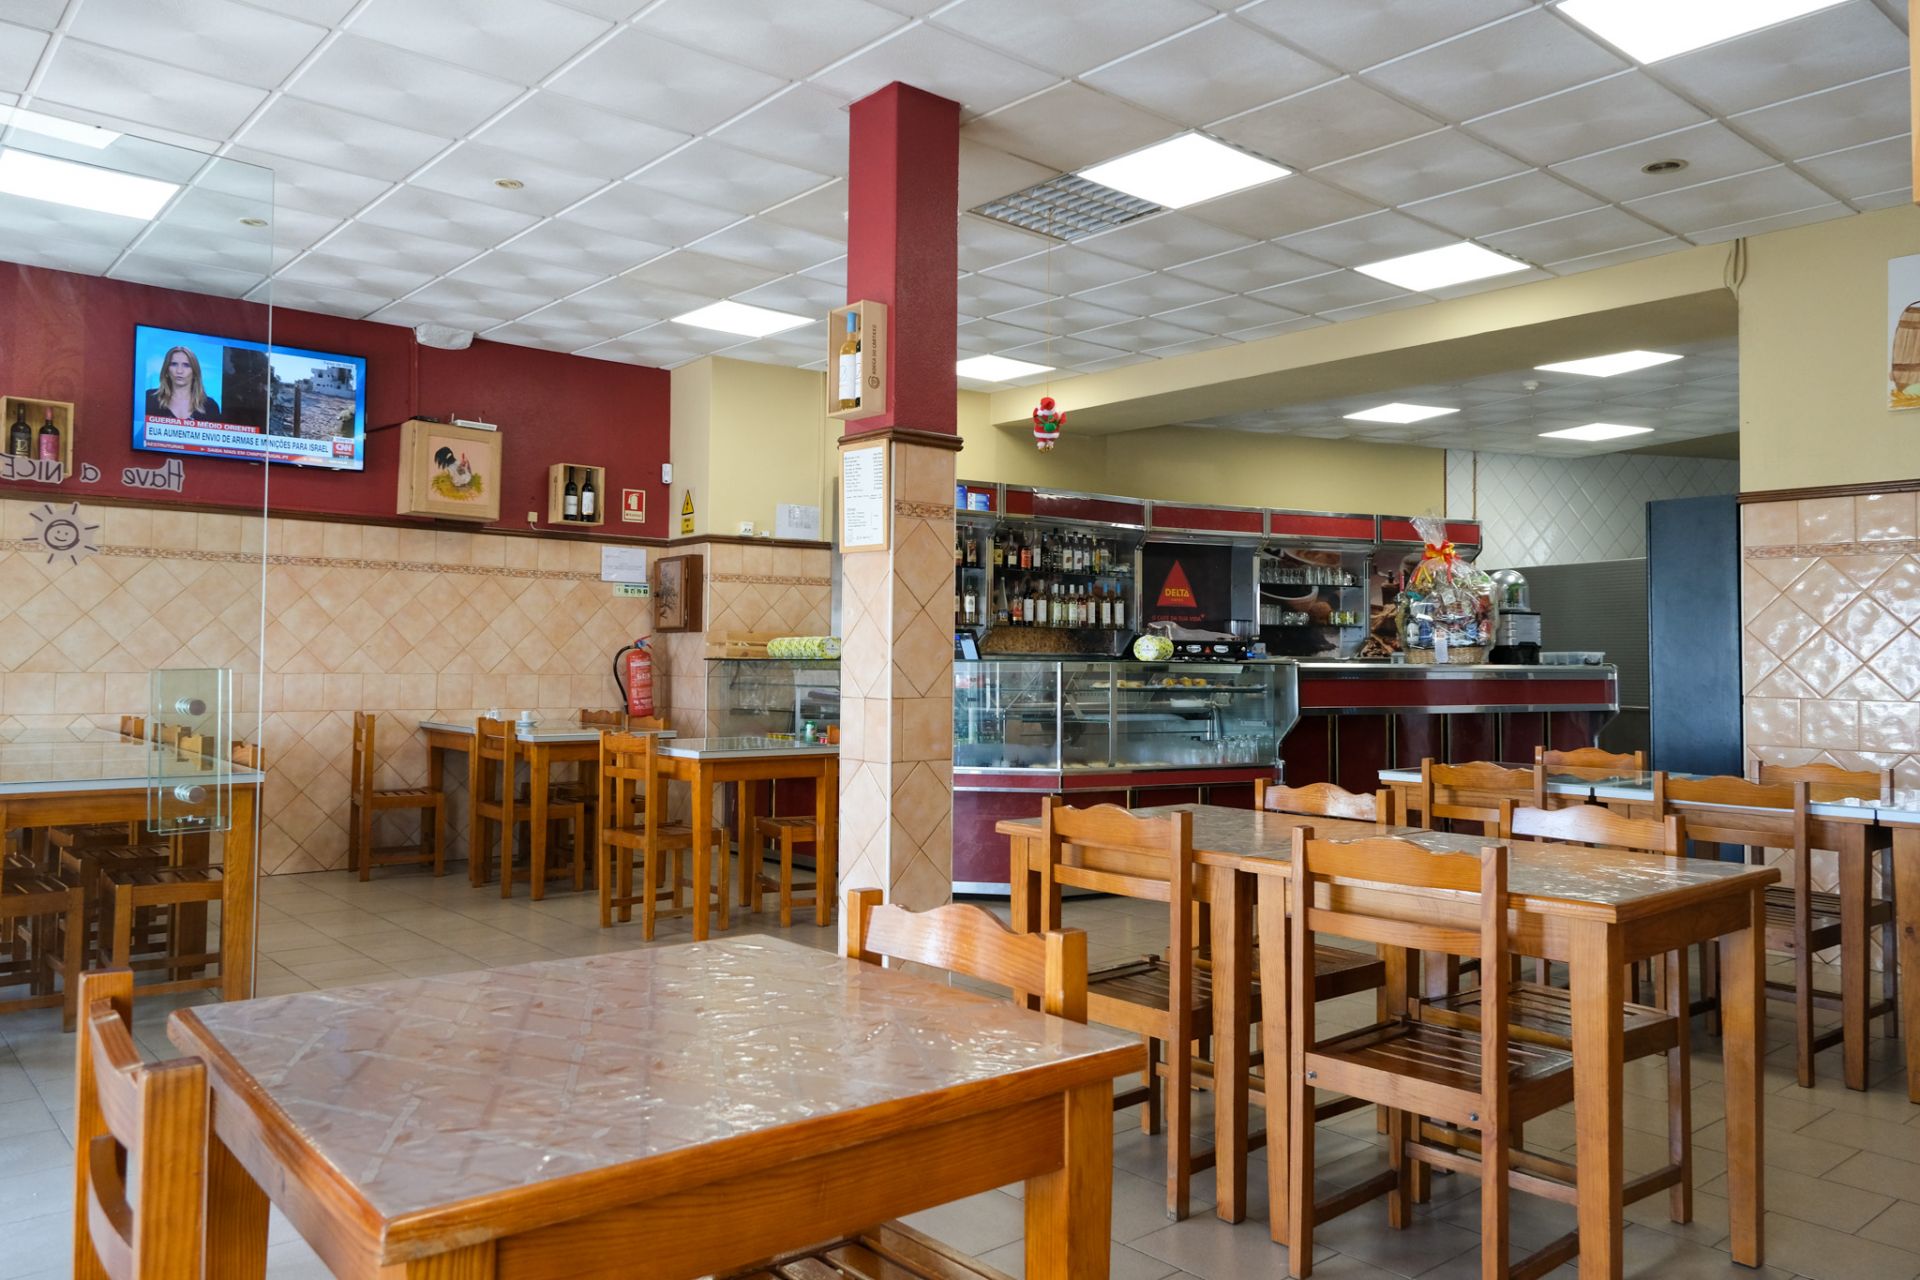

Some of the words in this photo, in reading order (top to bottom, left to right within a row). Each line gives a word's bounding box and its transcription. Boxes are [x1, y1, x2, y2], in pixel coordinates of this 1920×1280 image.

[149, 416, 182, 425] GUERRA
[197, 420, 223, 430] MÉDIO
[224, 423, 257, 433] ORIENTE
[148, 427, 162, 436] EUA
[163, 428, 200, 440] AUMENTAM
[202, 432, 220, 442] ENVIO
[222, 435, 231, 443] DE
[232, 435, 254, 446] ARMAS
[292, 441, 307, 451] PARA
[309, 443, 328, 453] ISRAEL
[335, 443, 352, 452] CNN
[1164, 588, 1190, 597] DELTA
